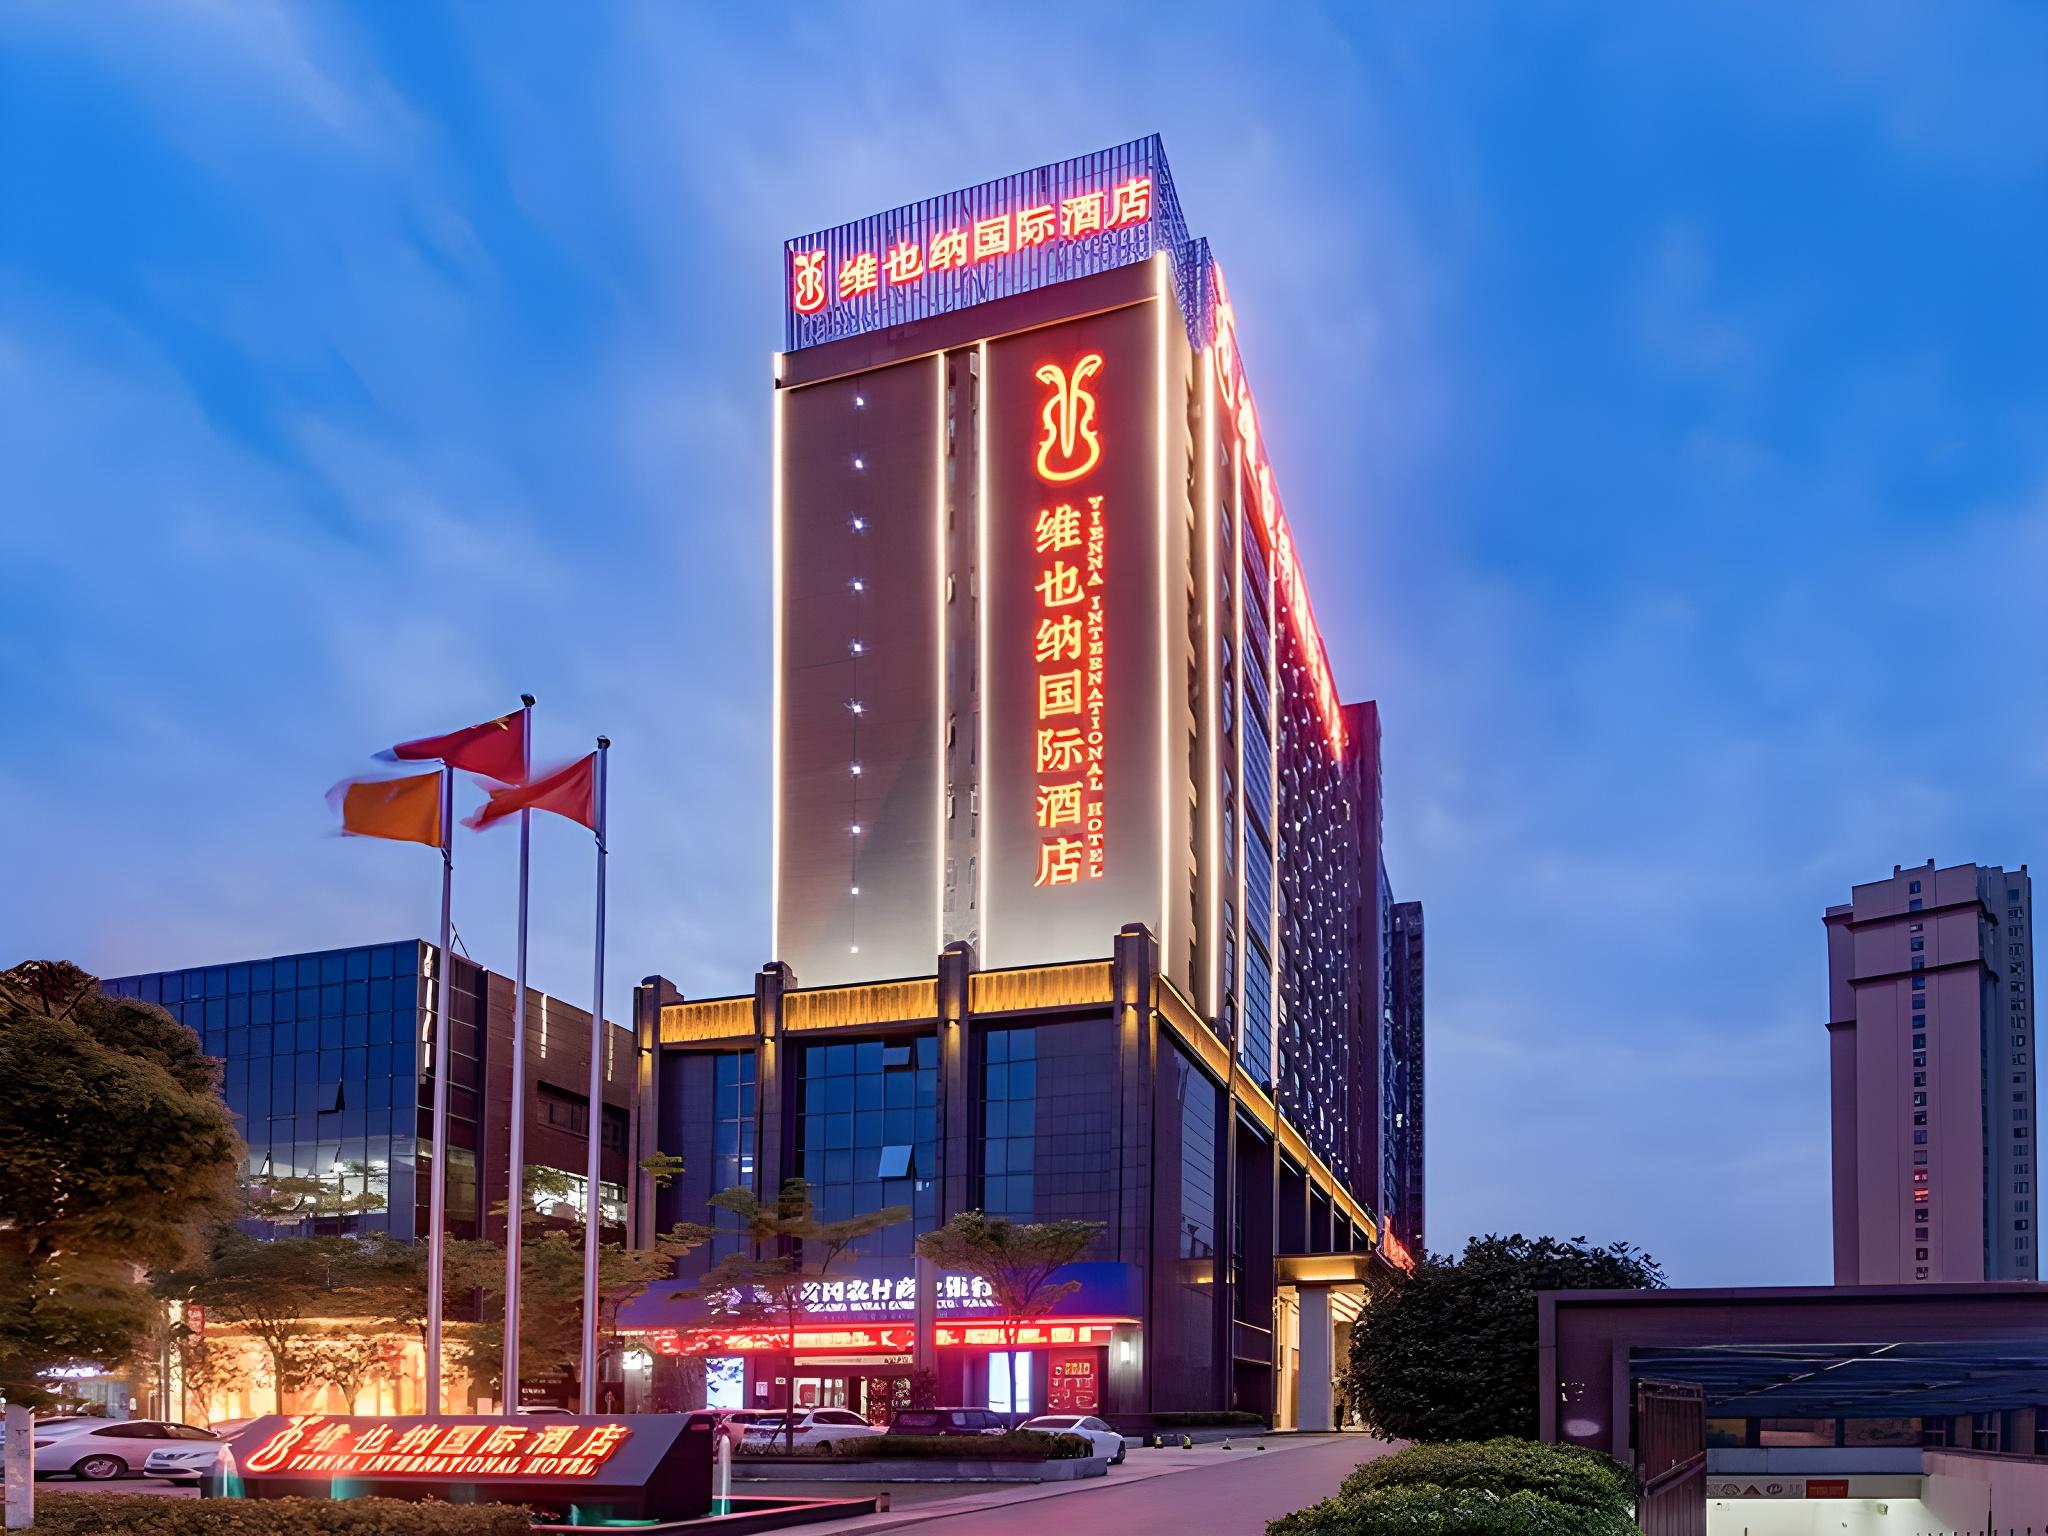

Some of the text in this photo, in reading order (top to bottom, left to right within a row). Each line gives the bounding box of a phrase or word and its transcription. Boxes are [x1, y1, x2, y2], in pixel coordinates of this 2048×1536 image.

[839, 177, 1151, 299] 维也纳国际酒店
[1034, 504, 1086, 887] 维也纳国际酒店
[1086, 495, 1104, 878] VIENNA INTERNATIONAL HOTEL
[287, 1454, 598, 1475] VIENNA INTERNATIONAL HOTEL
[301, 1423, 629, 1457] 维也纳国际酒店
